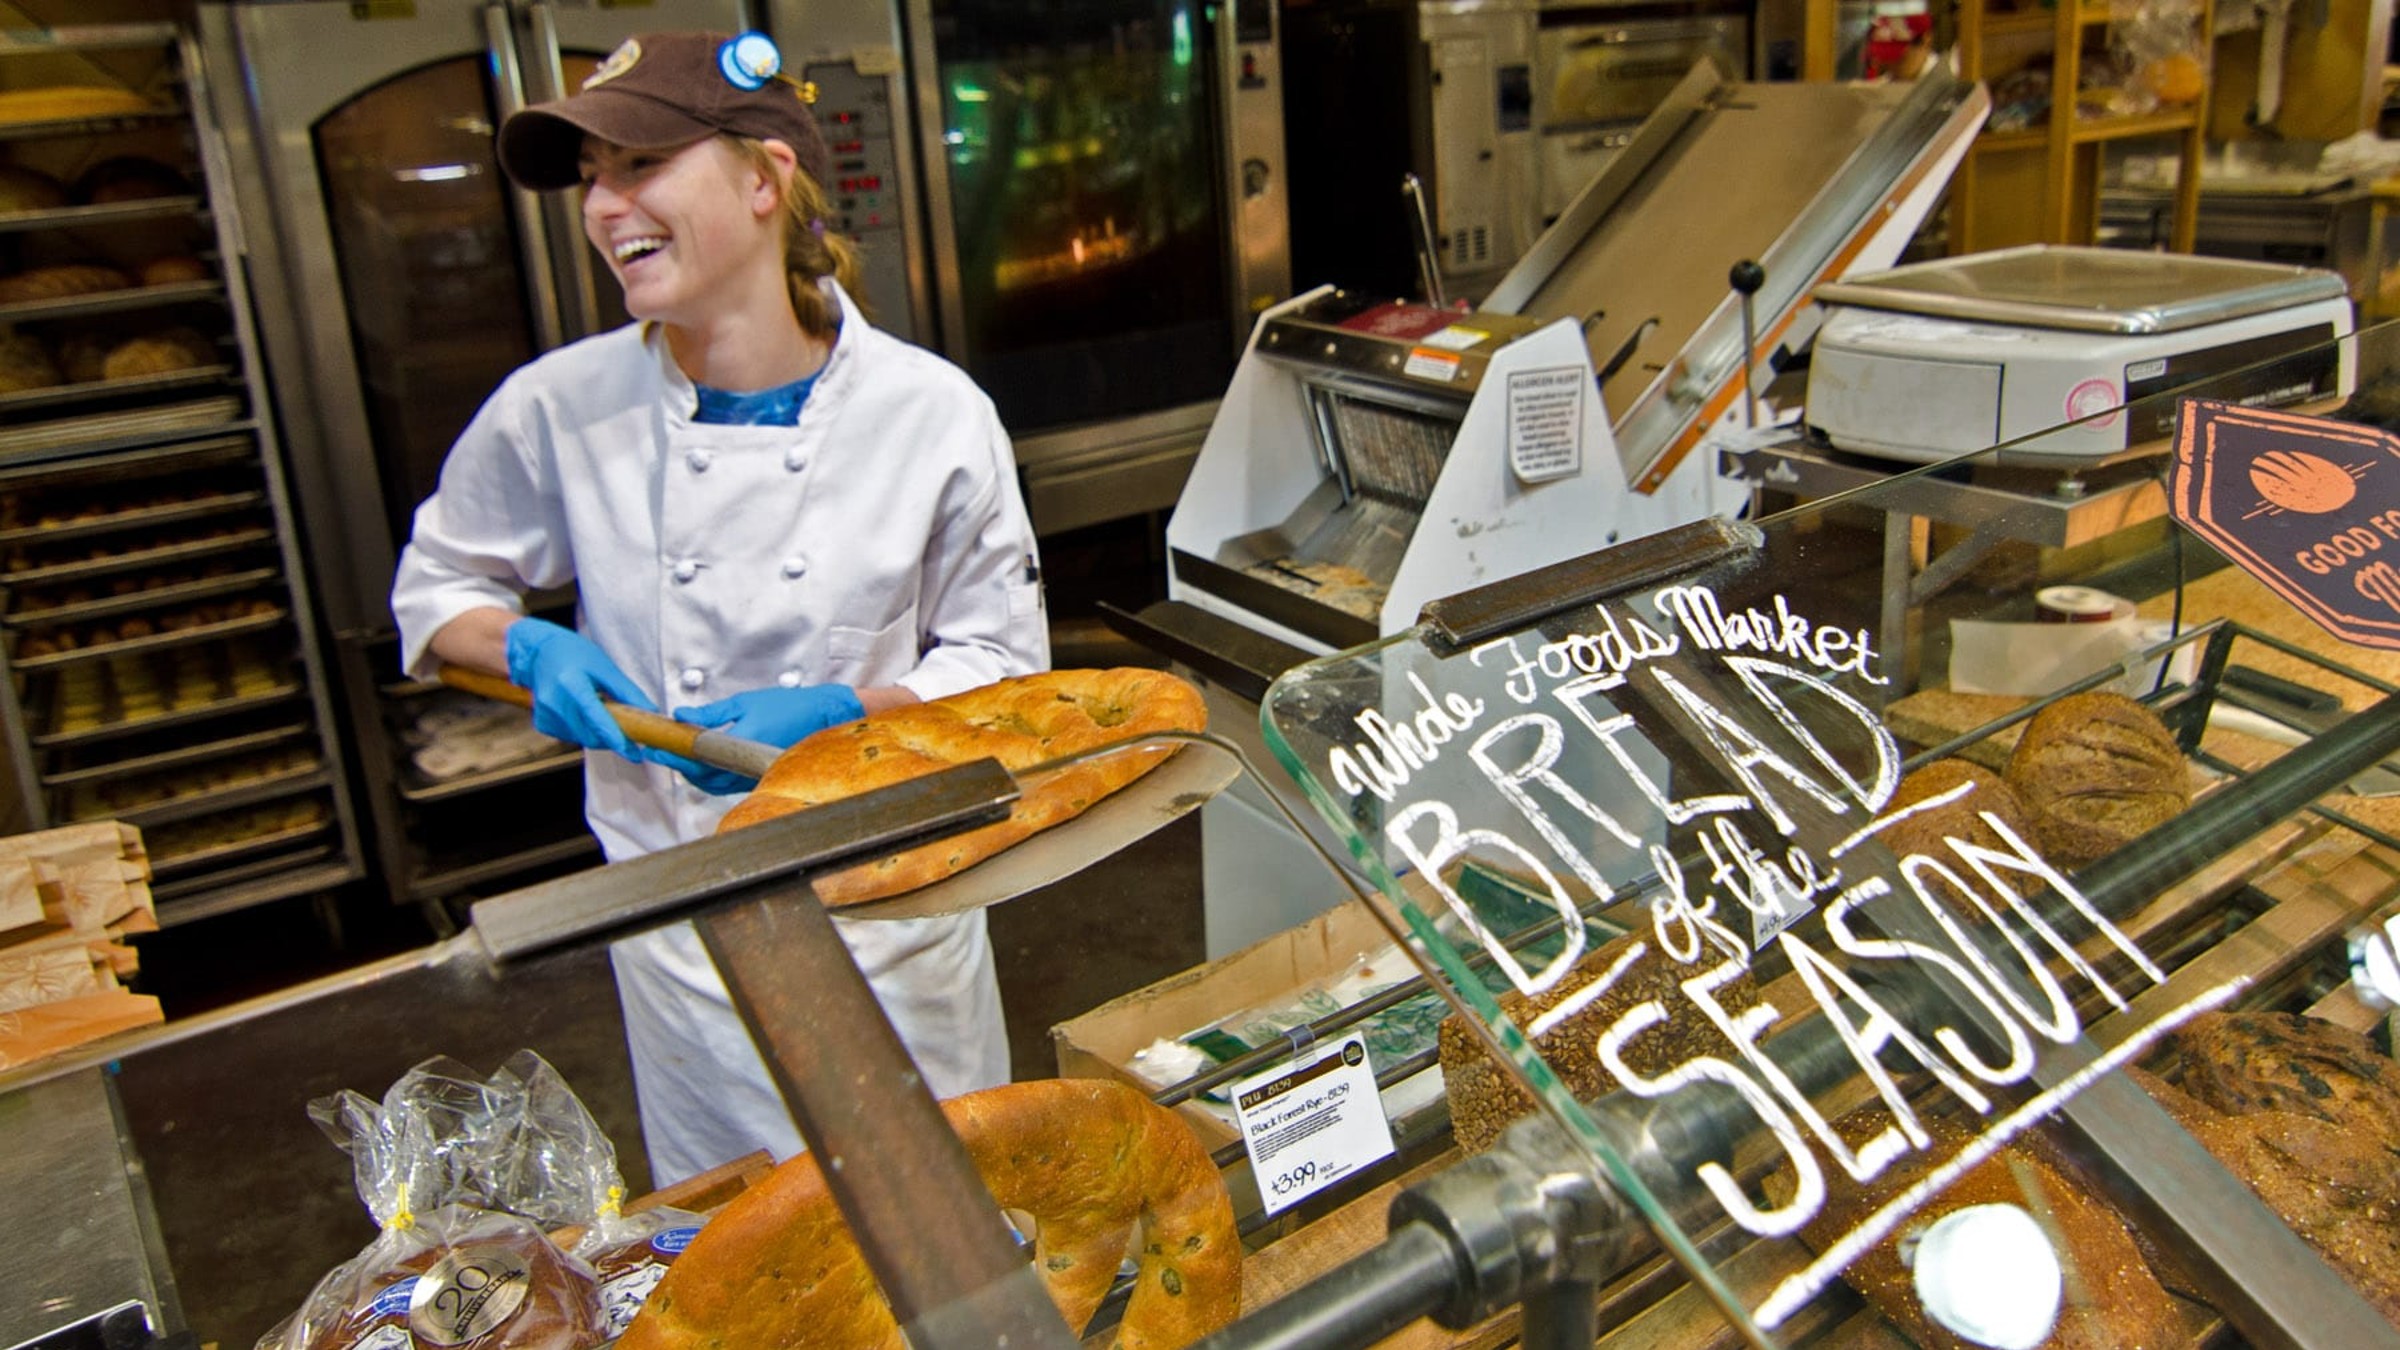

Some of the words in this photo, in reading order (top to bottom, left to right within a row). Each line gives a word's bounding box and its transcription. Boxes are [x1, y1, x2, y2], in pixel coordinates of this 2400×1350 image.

[2295, 526, 2382, 575] GOOD
[1329, 671, 1484, 802] Whole
[1471, 605, 1679, 706] Foods
[1655, 587, 1889, 685] Market
[1385, 656, 1901, 996] BREAD
[1699, 818, 1841, 917] the
[1649, 844, 1750, 964] of
[1598, 811, 2167, 1238] SEASON
[1250, 1116, 1277, 1137] Black
[1277, 1102, 1306, 1123] Forest
[435, 1266, 490, 1319] 20
